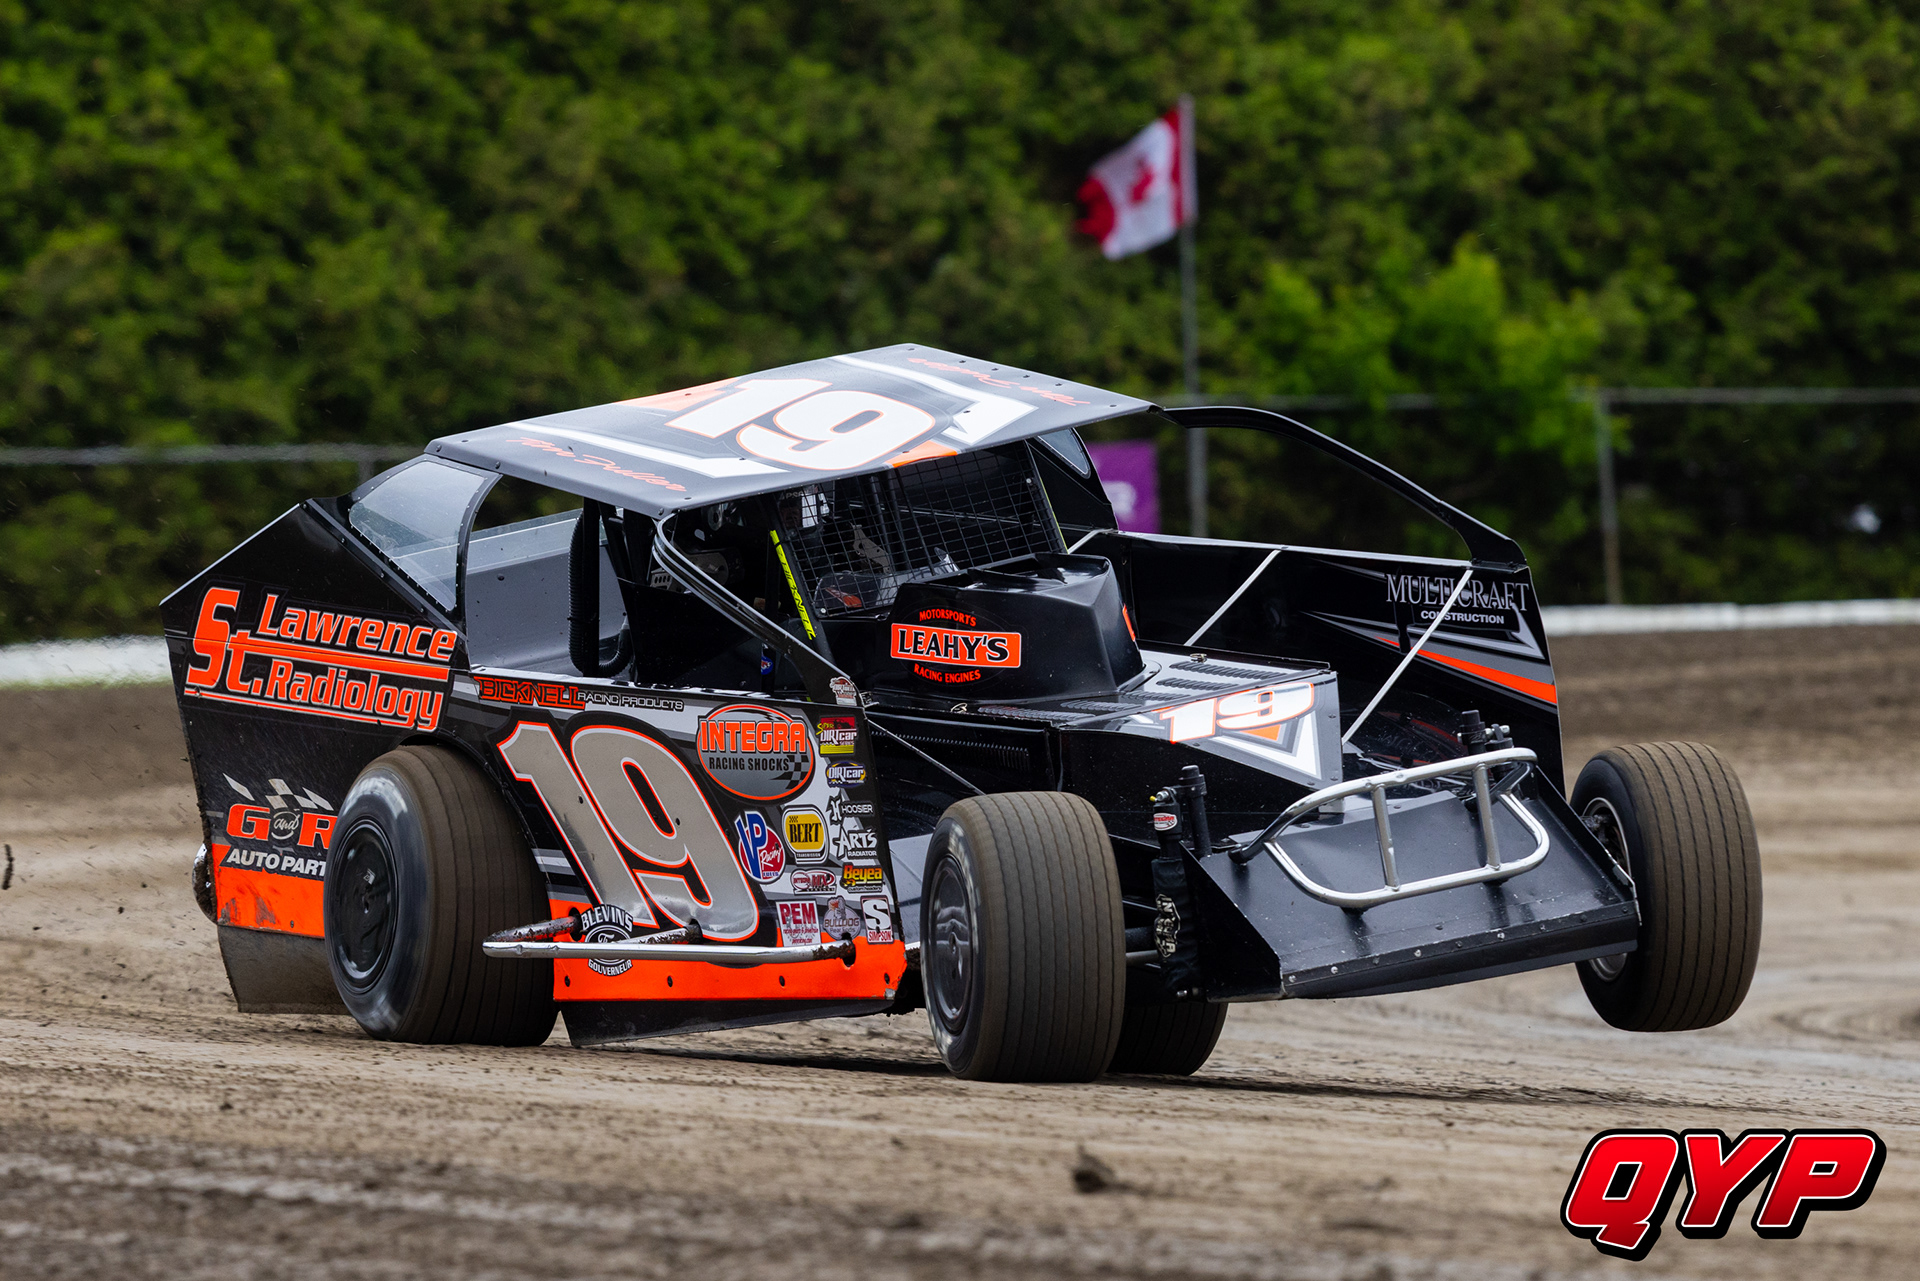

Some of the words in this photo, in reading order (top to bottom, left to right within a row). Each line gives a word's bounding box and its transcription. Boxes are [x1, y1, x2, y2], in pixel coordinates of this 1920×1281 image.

[664, 378, 935, 470] 19
[919, 608, 977, 627] MOTORSPORTS
[1421, 610, 1504, 624] COSTRUCTION
[187, 587, 263, 694] St.
[256, 593, 457, 661] Lawrence
[898, 628, 1009, 662] LEAHY'S
[914, 663, 942, 682] RACING
[945, 669, 981, 683] ENGINES
[266, 659, 444, 732] Radiology
[478, 677, 585, 710] BICKNELL
[578, 691, 619, 706] RACING
[621, 696, 684, 711] PRODUCTS
[1159, 682, 1314, 744] 19
[701, 721, 806, 753] INTEGRA
[709, 757, 745, 771] RACING
[747, 757, 789, 771] SHOCKS
[226, 803, 271, 841] G
[273, 813, 300, 831] and
[841, 805, 873, 813] HOOSIER
[497, 720, 760, 942] 19
[789, 822, 822, 843] BERT
[834, 828, 877, 857] ART'S
[226, 848, 280, 869] AUTO
[735, 811, 768, 880] VP
[843, 865, 882, 882] Beyea
[581, 906, 633, 932] BLEVINS
[779, 903, 817, 924] PEM
[824, 918, 860, 927] BULLDOG
[862, 899, 890, 930] S
[869, 930, 892, 942] SIMPSON
[588, 959, 633, 976] GOUVERNEUR
